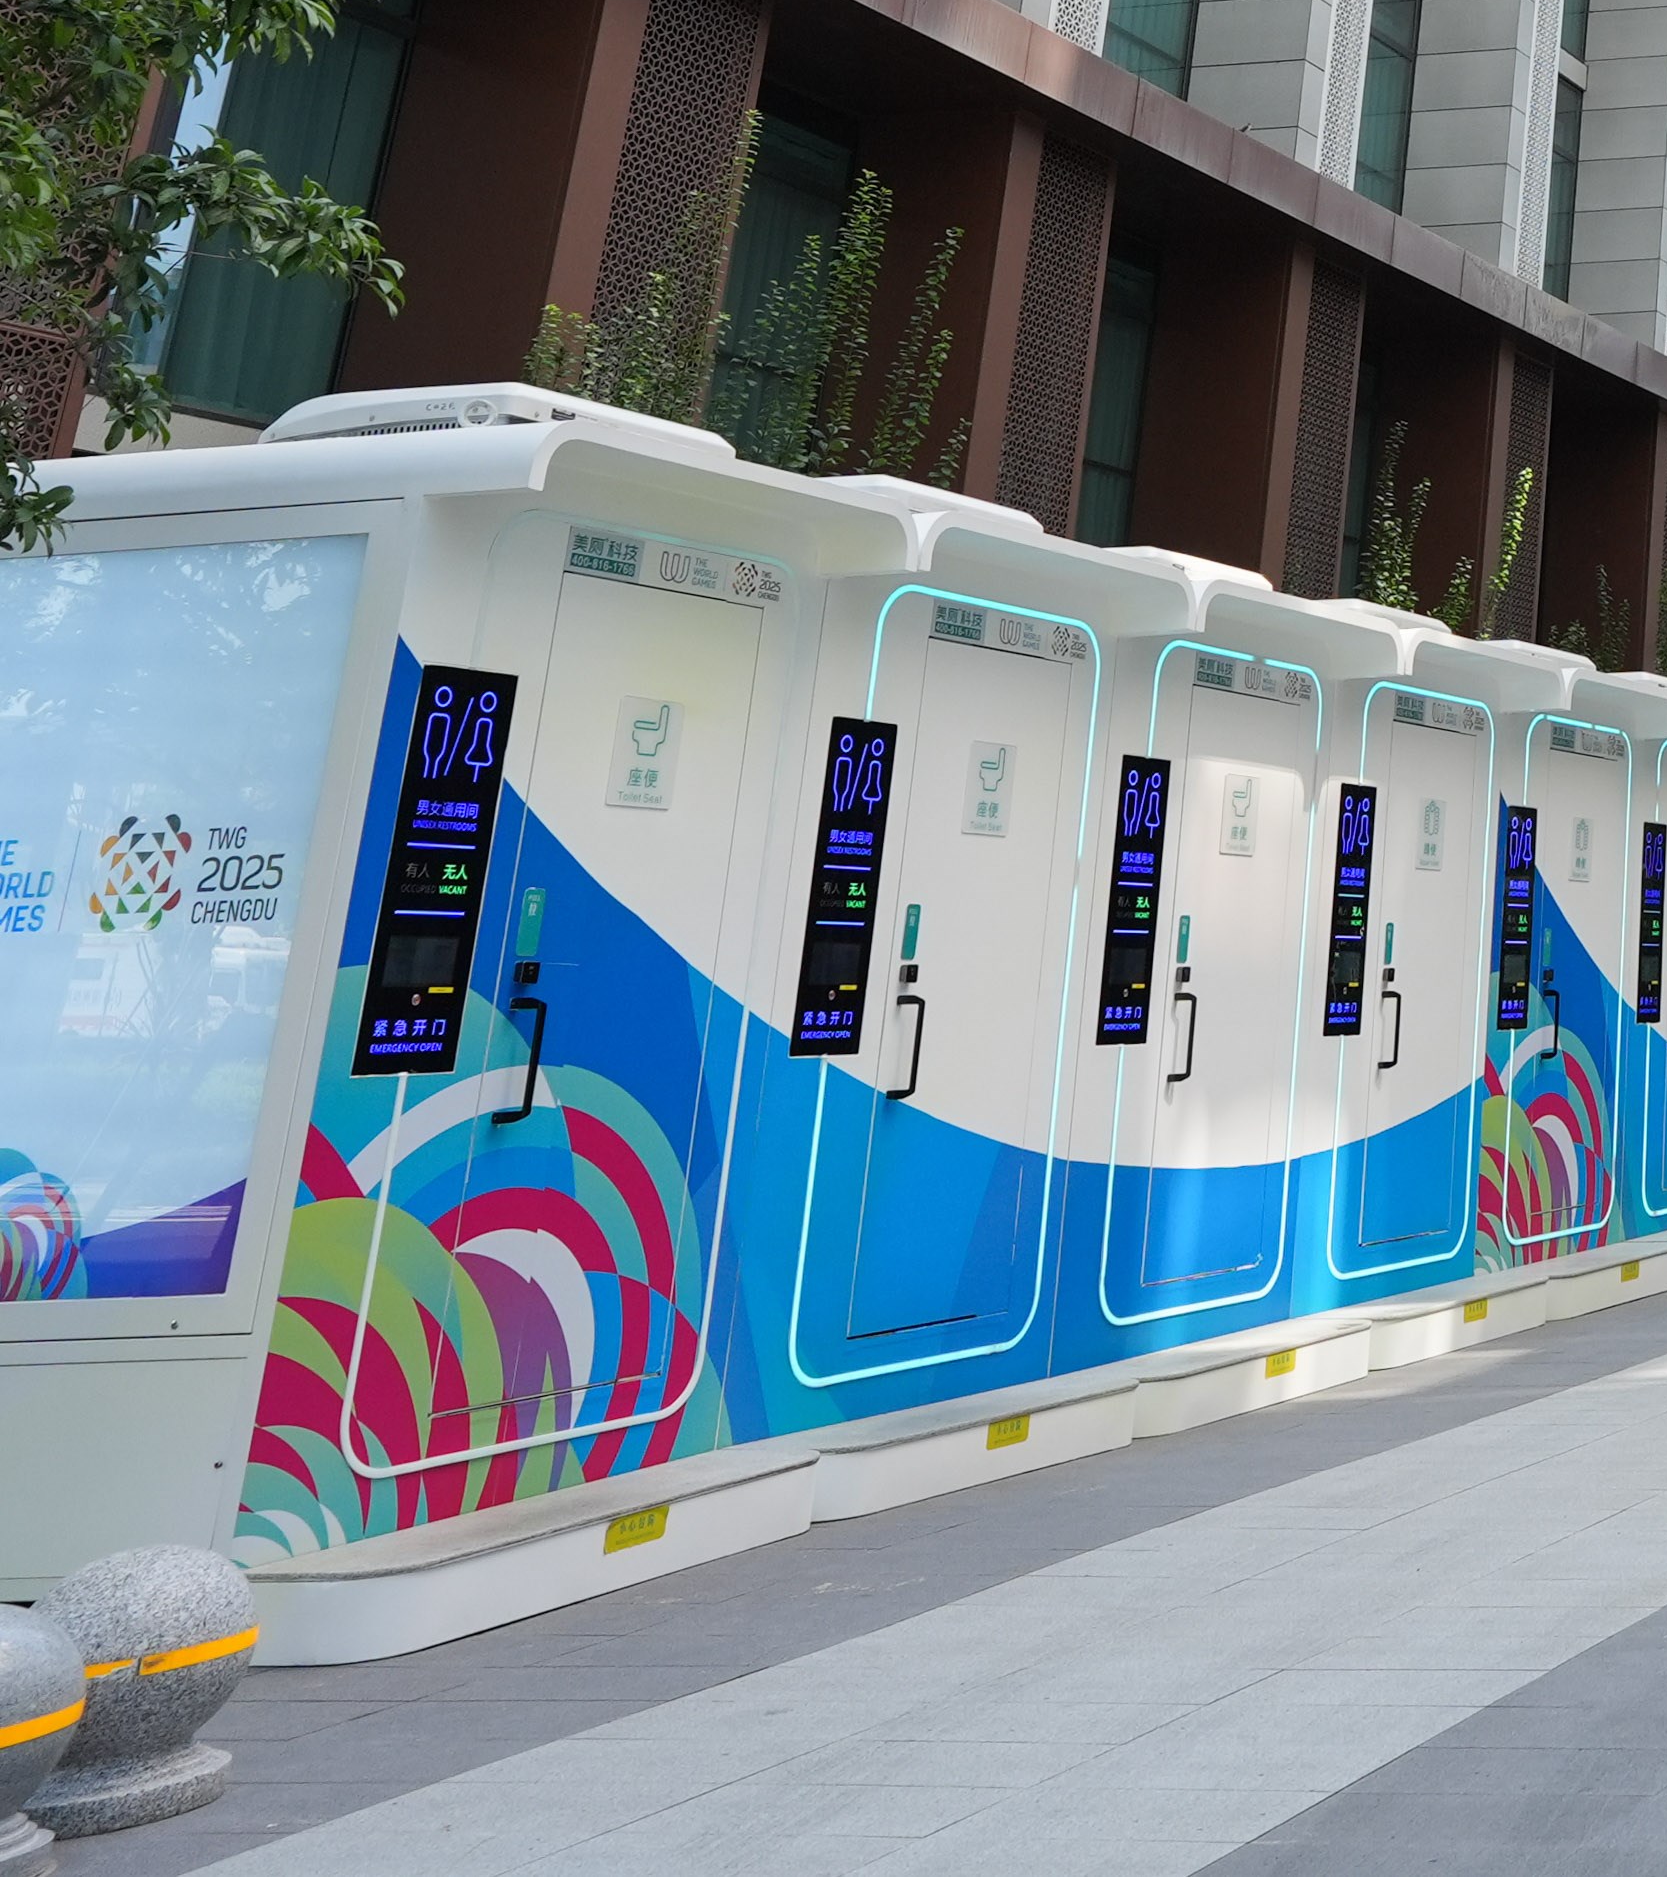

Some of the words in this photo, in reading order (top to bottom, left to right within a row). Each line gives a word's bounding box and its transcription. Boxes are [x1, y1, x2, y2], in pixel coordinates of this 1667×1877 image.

[759, 578, 781, 593] 2025
[627, 767, 660, 788] 座便
[416, 799, 480, 819] 男女通用间
[208, 826, 248, 850] TWG
[196, 853, 286, 893] 2025
[405, 863, 430, 879] 有人
[442, 864, 468, 880] 无人
[0, 870, 55, 900] RLD
[438, 884, 468, 896] VACANT
[848, 882, 867, 897] 无人
[191, 897, 279, 924] CHENGDU
[373, 1019, 446, 1037] 紧急开门
[369, 1042, 419, 1054] EMERGENCY
[419, 1042, 443, 1052] OPEN
